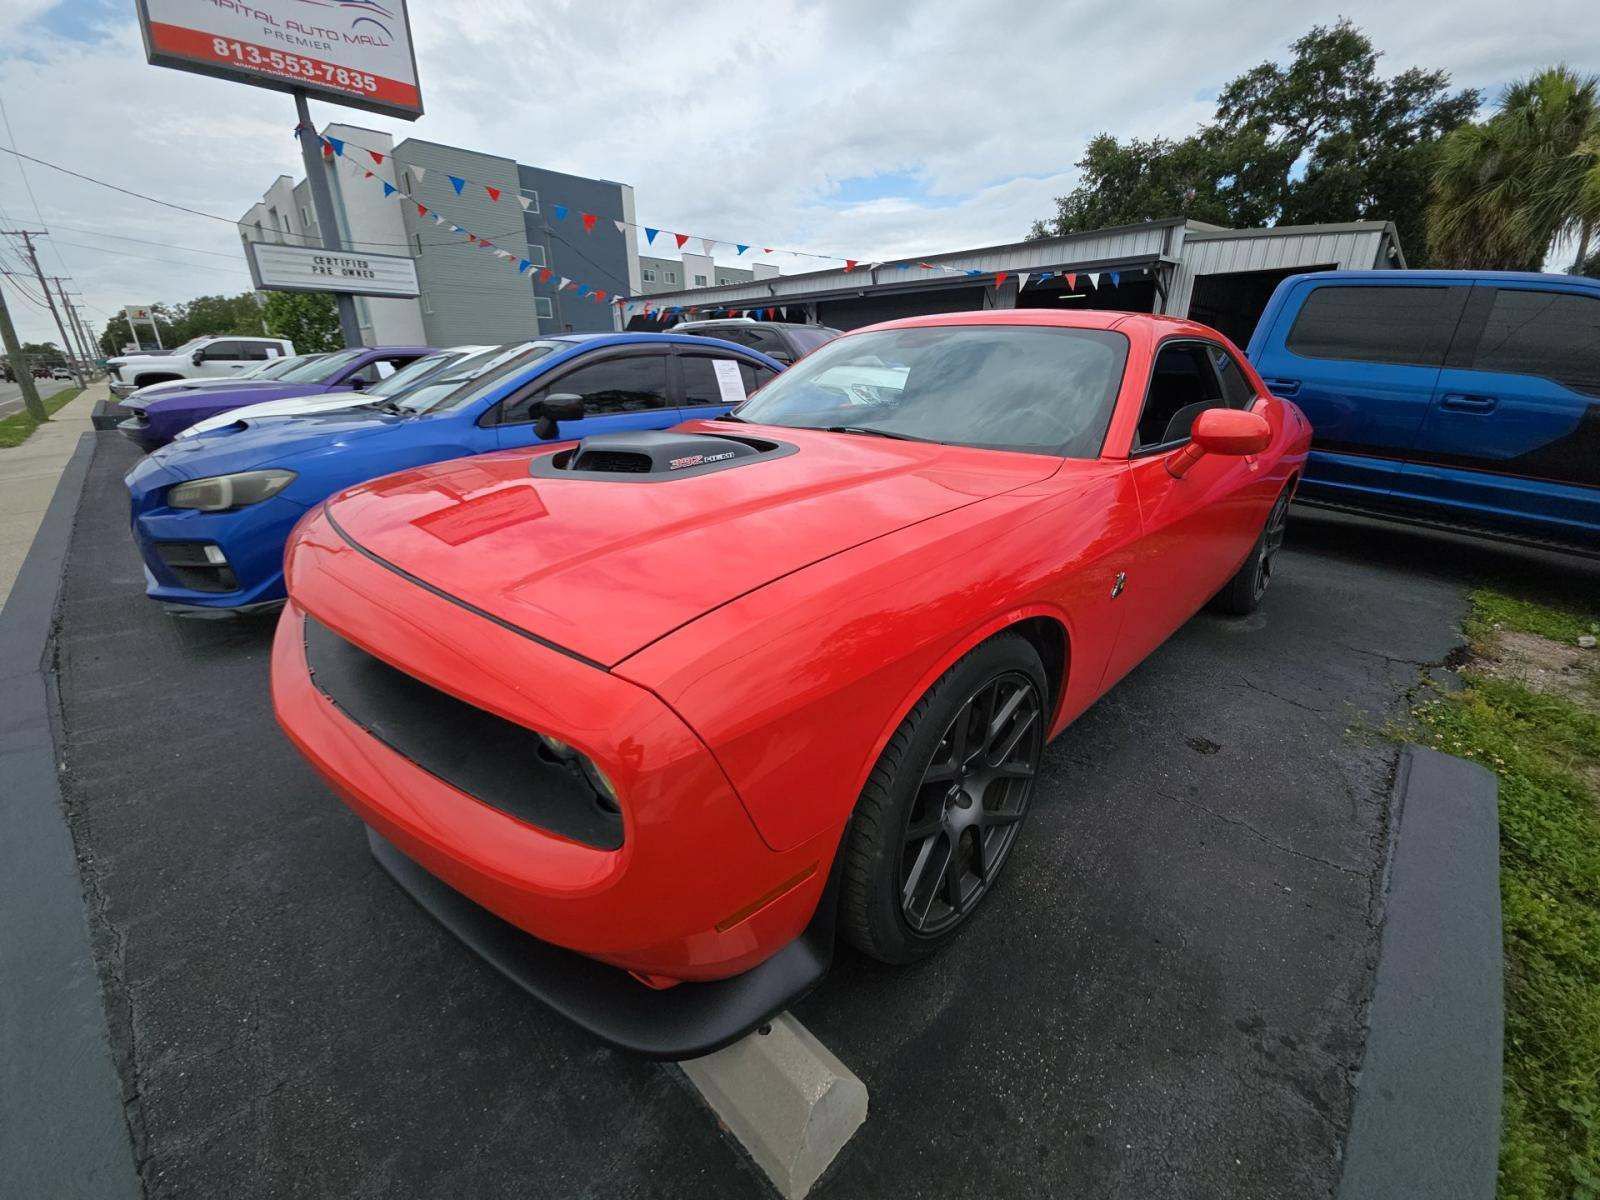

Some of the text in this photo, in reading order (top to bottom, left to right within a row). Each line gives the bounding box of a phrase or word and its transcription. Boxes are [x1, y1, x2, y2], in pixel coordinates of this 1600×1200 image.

[263, 27, 332, 51] PREMIER
[286, 20, 339, 41] AUTO
[342, 33, 389, 46] MALL
[212, 37, 378, 92] 813-553-7835
[312, 266, 375, 278] PRE OWNED
[313, 256, 369, 268] CERTIFIED
